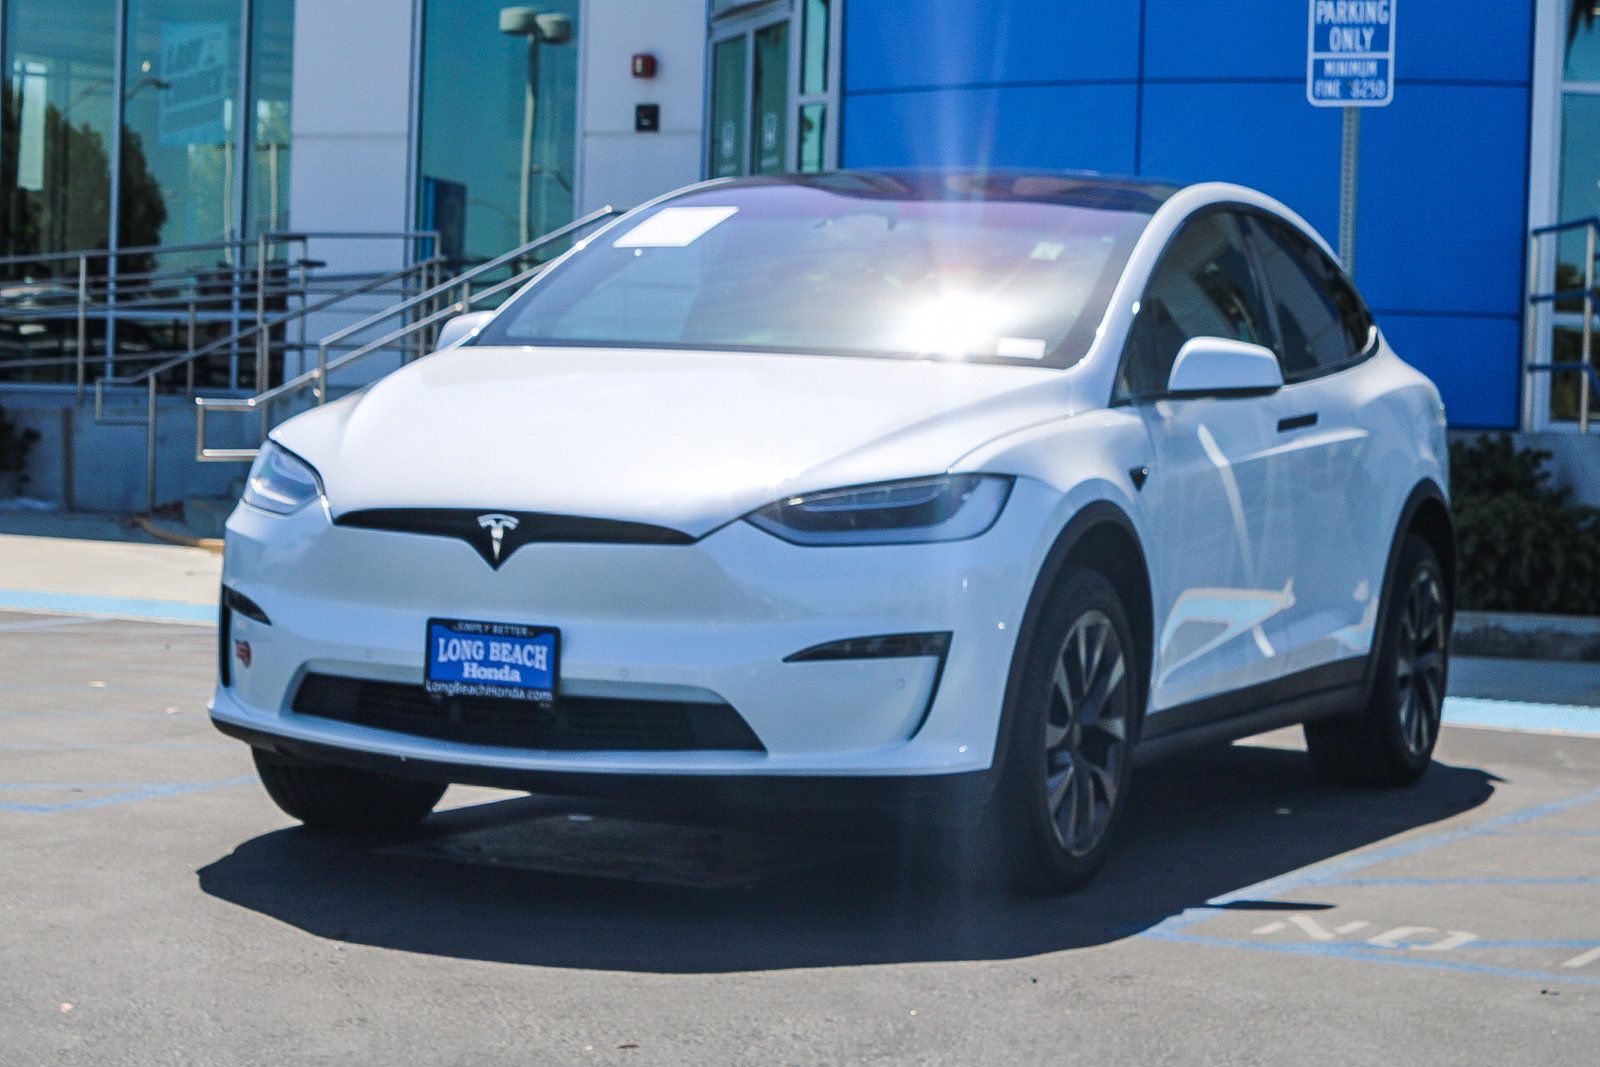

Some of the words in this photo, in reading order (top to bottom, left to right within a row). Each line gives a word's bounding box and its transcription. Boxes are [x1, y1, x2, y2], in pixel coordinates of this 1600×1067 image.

[1316, 0, 1390, 24] PARKING
[1329, 26, 1374, 52] ONLY
[1323, 61, 1377, 77] MINIMUM
[1315, 79, 1340, 98] FINE
[438, 637, 485, 663] LONG
[489, 641, 549, 672] BEACH
[463, 661, 522, 682] Honda
